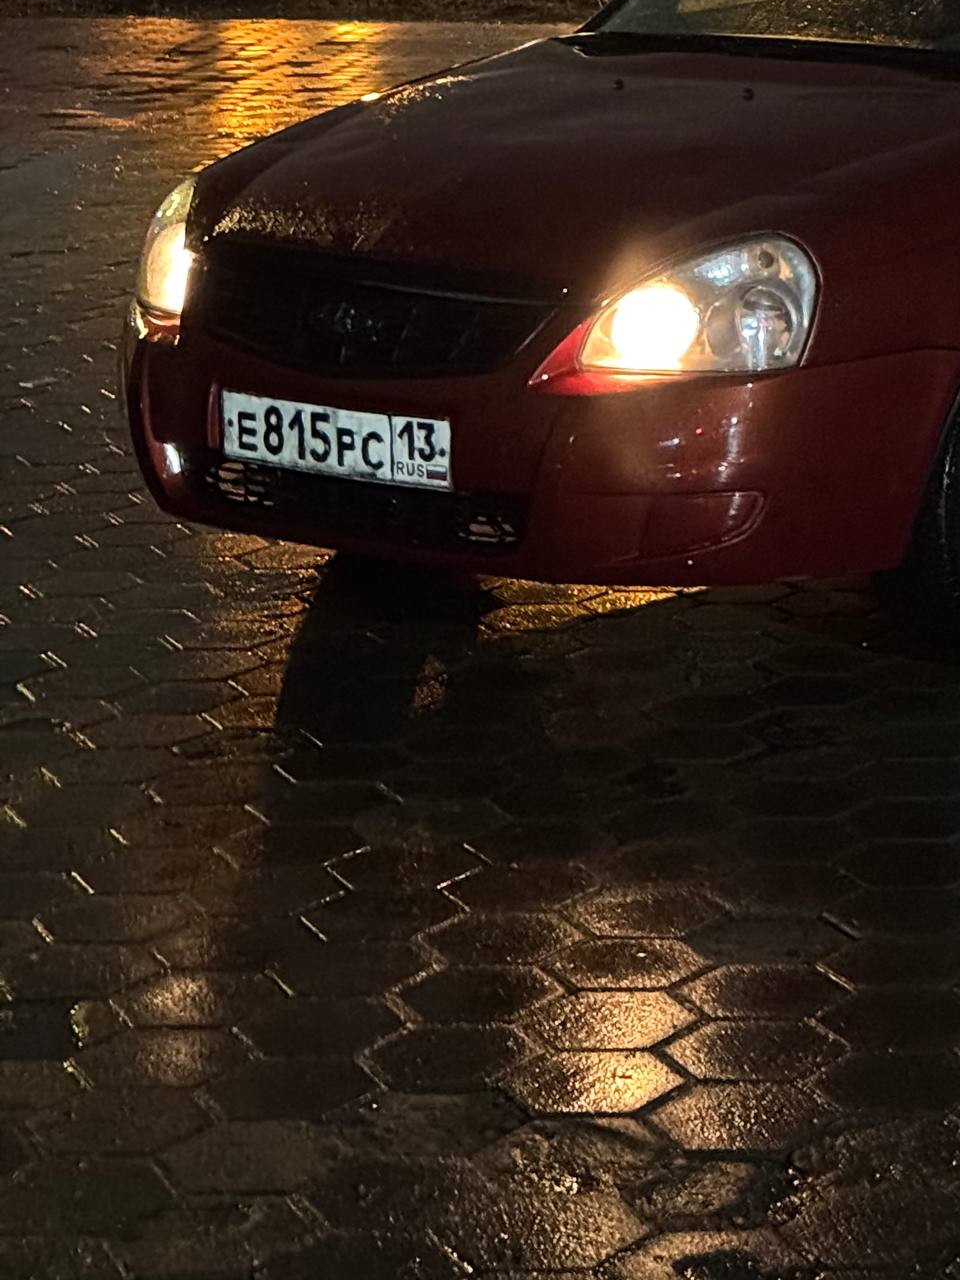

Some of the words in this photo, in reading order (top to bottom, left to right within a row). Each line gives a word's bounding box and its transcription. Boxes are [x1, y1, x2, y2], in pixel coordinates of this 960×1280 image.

[237, 405, 385, 471] Е815РС
[397, 420, 436, 462] 13
[396, 461, 425, 478] RUS
